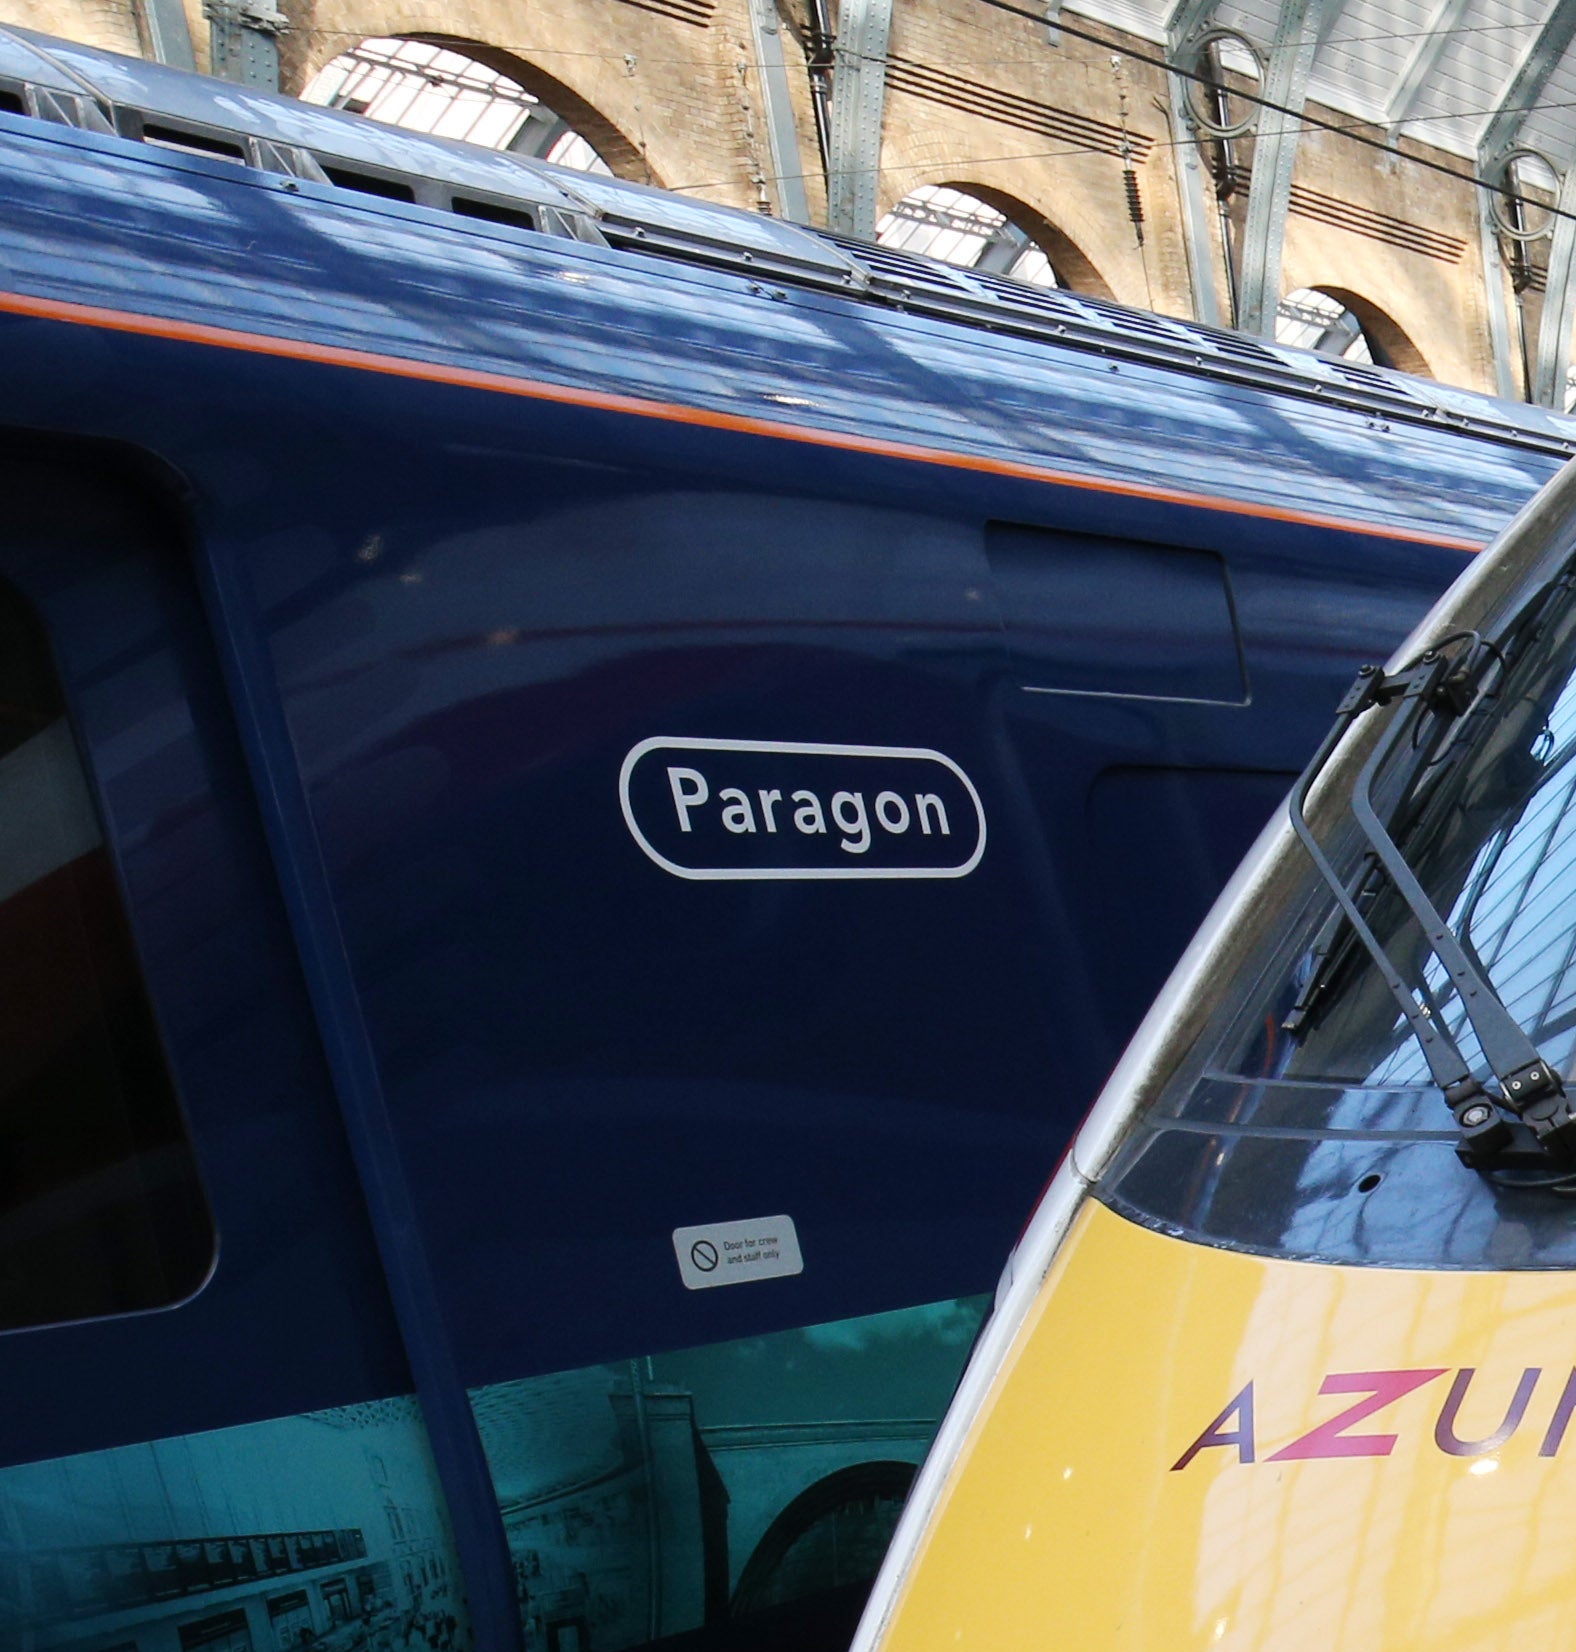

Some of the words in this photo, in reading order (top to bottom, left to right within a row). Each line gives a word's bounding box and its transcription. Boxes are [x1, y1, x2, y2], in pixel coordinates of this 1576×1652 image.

[667, 767, 950, 853] Paragon
[724, 1240, 744, 1251] Door
[728, 1254, 743, 1264] and
